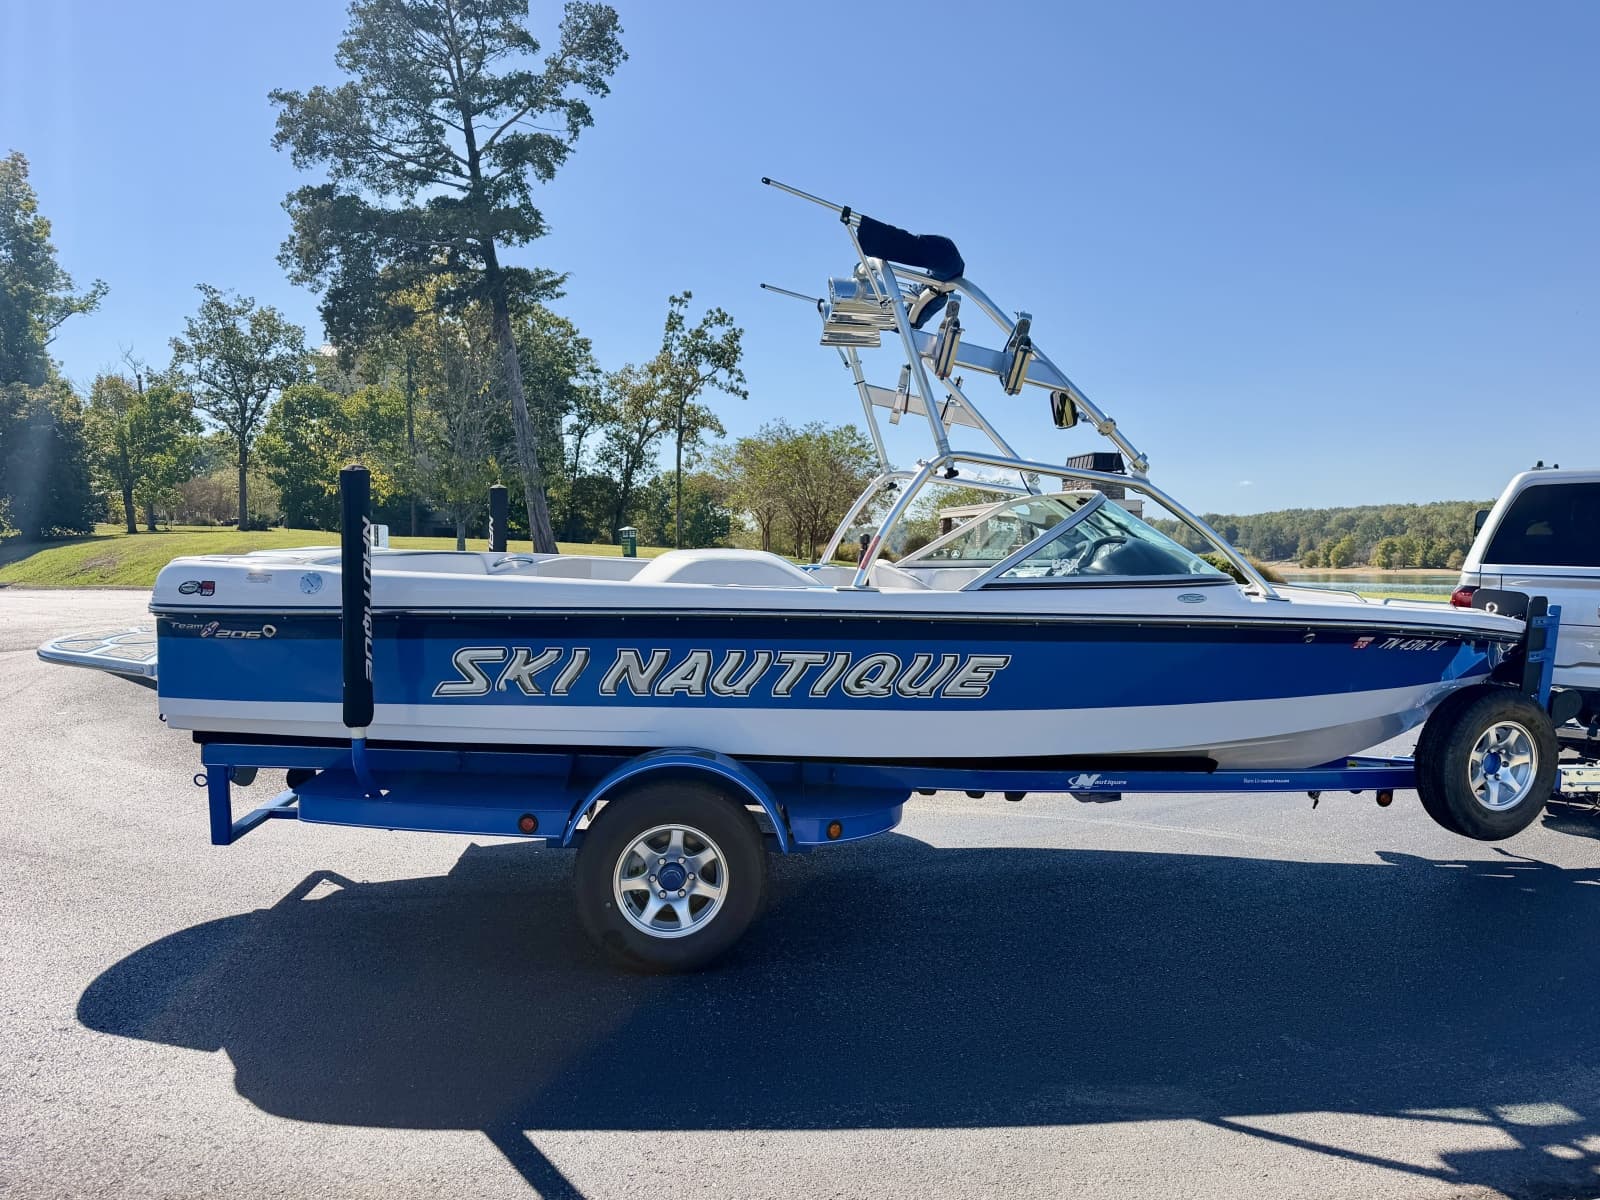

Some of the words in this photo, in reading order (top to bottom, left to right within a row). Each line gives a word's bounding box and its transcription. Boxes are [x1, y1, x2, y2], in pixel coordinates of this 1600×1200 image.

[216, 630, 262, 639] 206
[431, 646, 591, 697] SKI
[598, 647, 1012, 698] NAUTIQUE
[1068, 773, 1127, 789] Nautique
